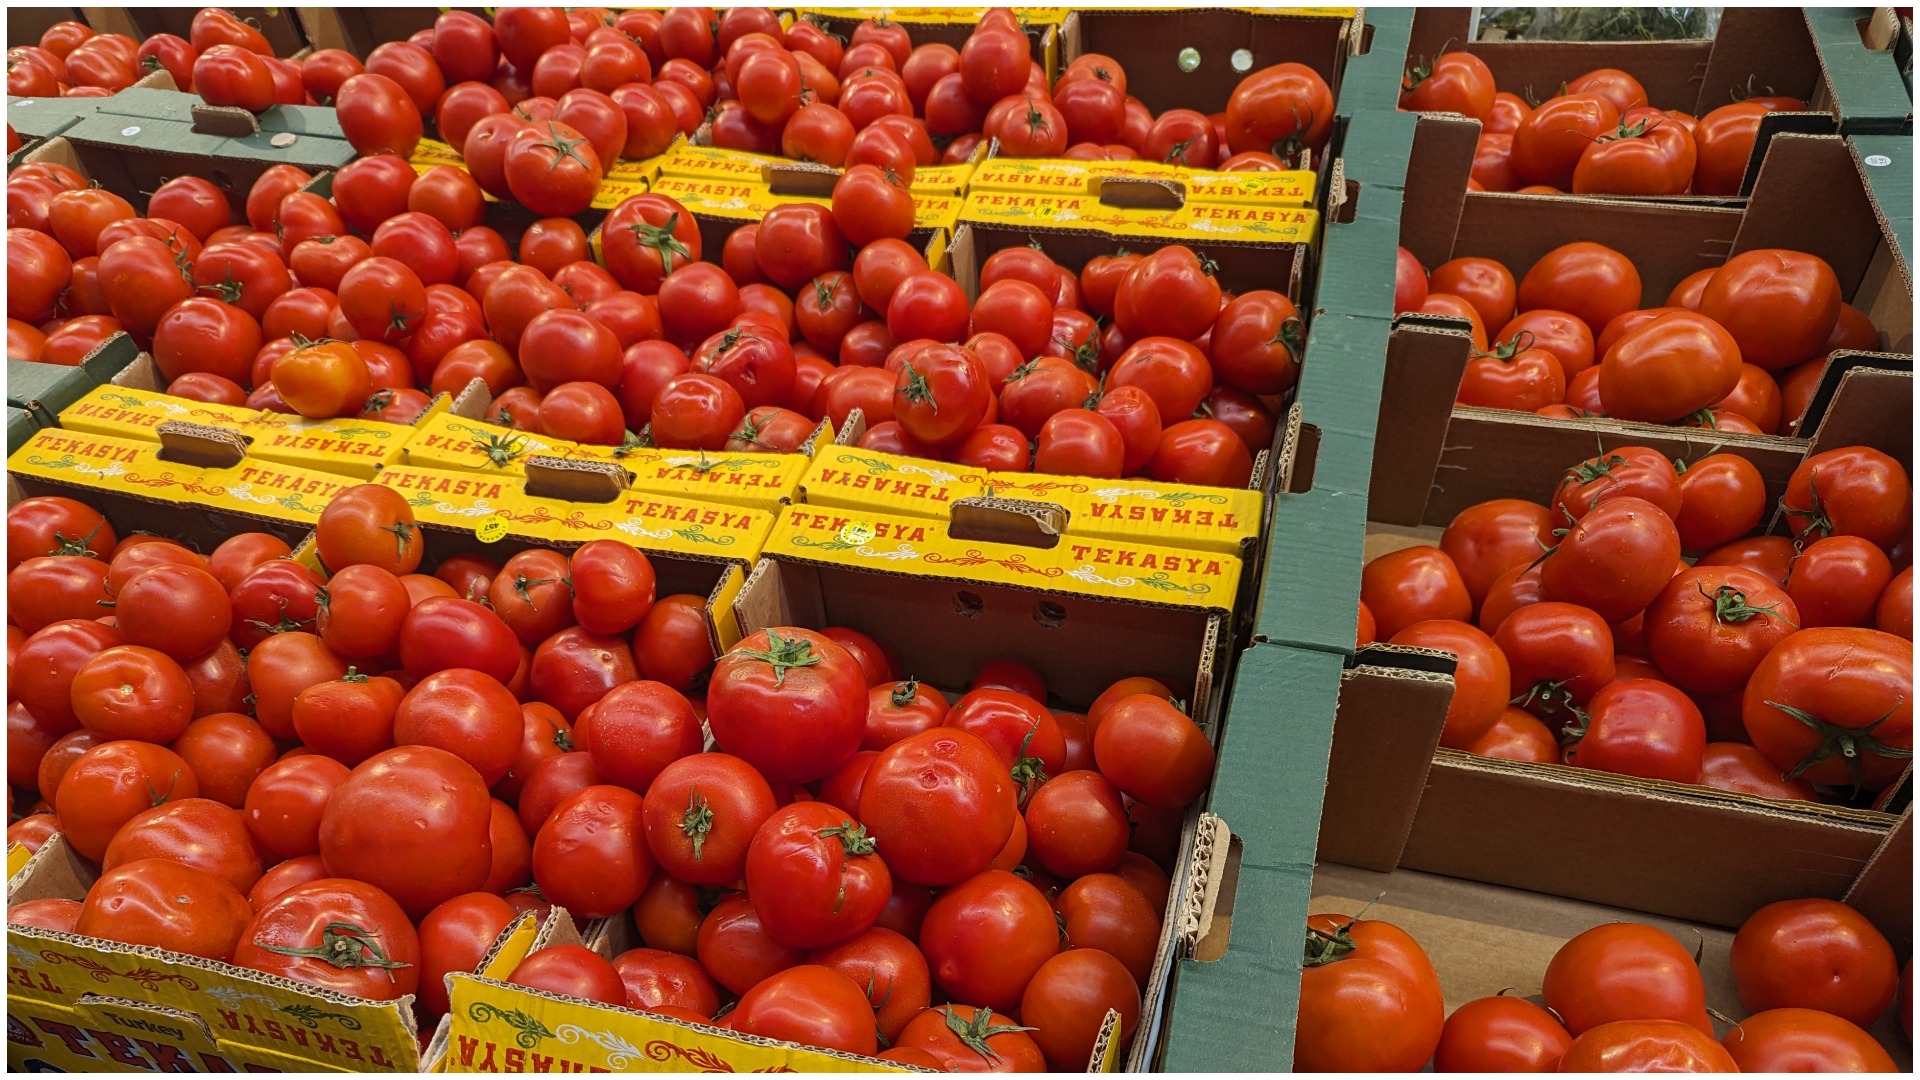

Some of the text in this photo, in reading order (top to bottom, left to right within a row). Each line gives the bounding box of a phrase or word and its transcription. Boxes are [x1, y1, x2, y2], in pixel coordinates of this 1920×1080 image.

[672, 157, 762, 174] TEKASYA
[657, 179, 751, 198] TEKASYA
[982, 173, 1083, 187] TEKASYA
[1192, 207, 1307, 224] TEKASYA
[76, 403, 166, 427] EKASYA
[34, 435, 141, 464] TEKASYA
[271, 434, 386, 458] TEKASYA
[382, 471, 501, 500] TEKASYA
[656, 467, 783, 489] TEKASYA
[821, 468, 950, 502] TEKASYA
[624, 499, 752, 531] TEKASYA
[790, 511, 926, 543] TEKSYA
[1090, 502, 1239, 529] TEKASYA
[1071, 544, 1222, 576] TEKASYA
[102, 1011, 186, 1042] Turkey
[216, 1007, 395, 1069] TEKASYA
